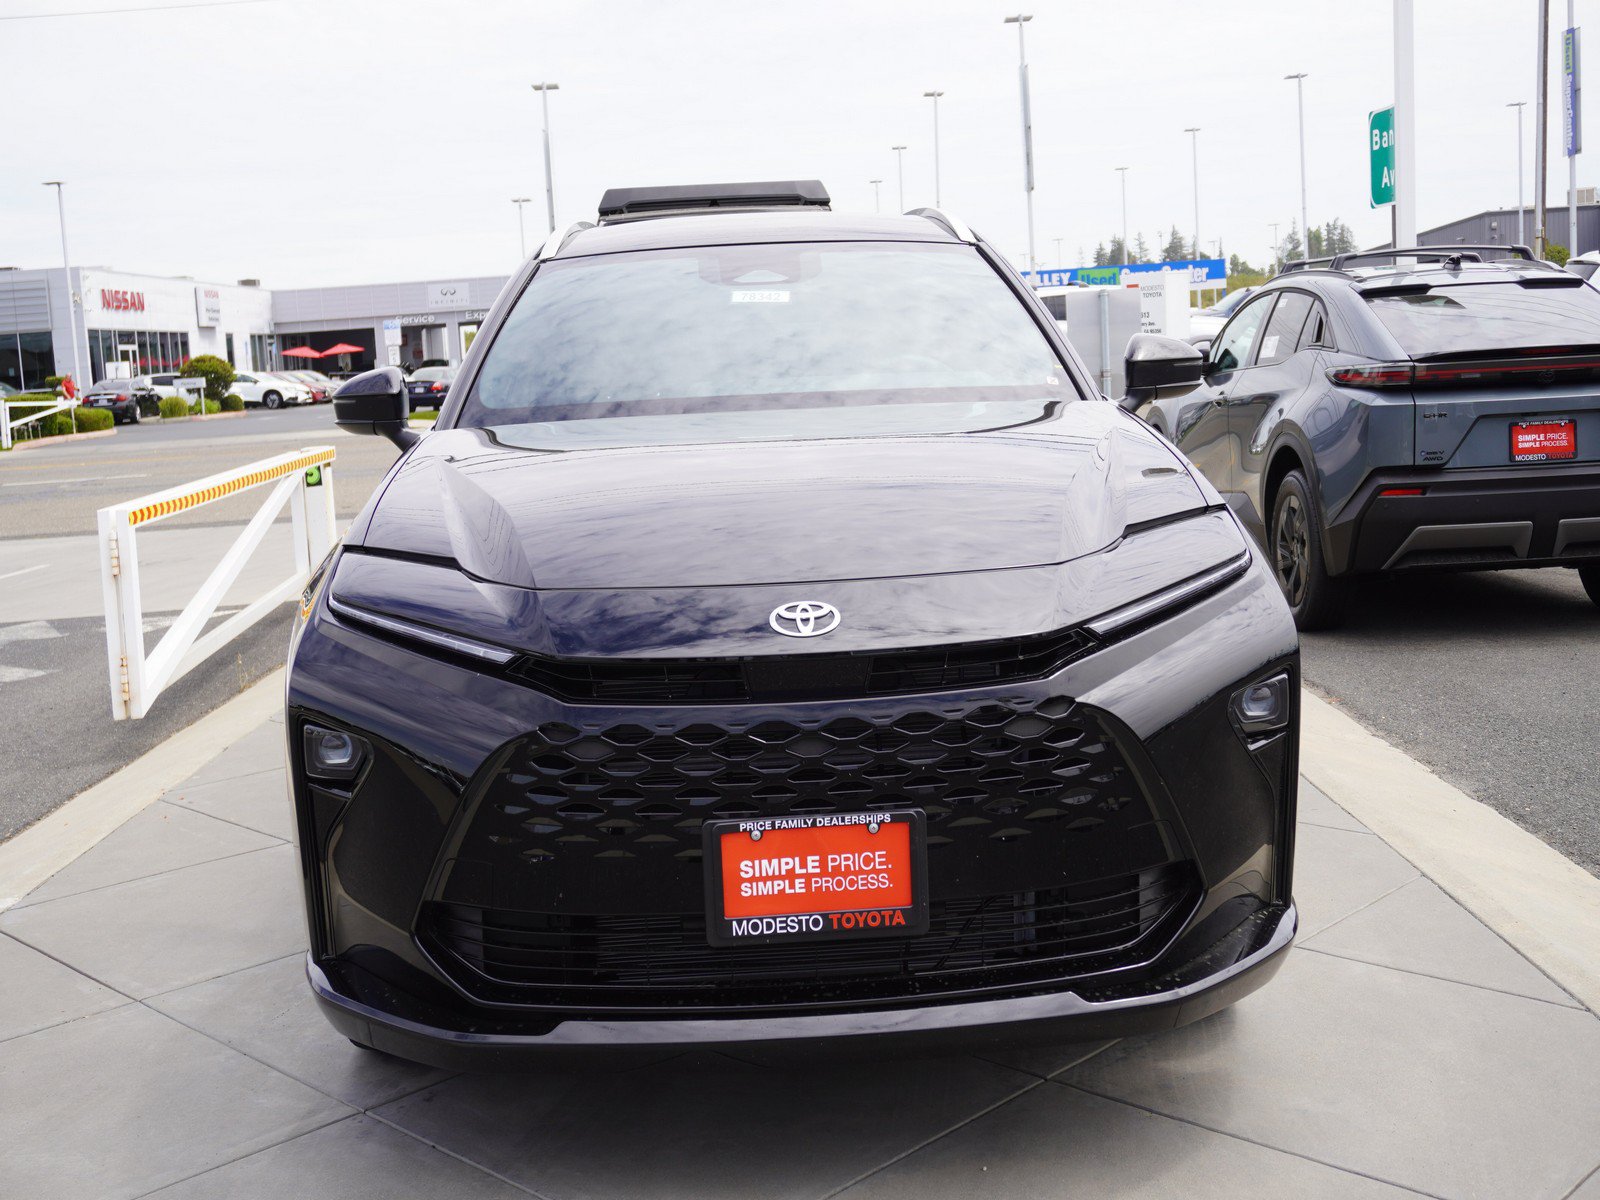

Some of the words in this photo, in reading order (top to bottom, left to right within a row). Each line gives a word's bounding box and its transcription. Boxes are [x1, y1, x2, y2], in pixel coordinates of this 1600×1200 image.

[1372, 129, 1394, 151] Ban
[1381, 166, 1395, 188] Av
[1025, 272, 1071, 287] LLEY
[1081, 273, 1117, 285] Used
[101, 289, 145, 312] NISSAN
[741, 292, 781, 301] 78342
[395, 315, 435, 324] Service
[465, 311, 488, 321] Exp
[1518, 433, 1545, 442] SIMPLE
[1546, 432, 1568, 440] PRICE.
[1515, 453, 1546, 461] MODESTO
[1547, 452, 1574, 460] TOYOTA
[739, 820, 772, 832] PRICE
[775, 818, 814, 830] FAMILY
[816, 813, 891, 827] DEALERSHIPS
[739, 855, 820, 878] SIMPLE
[827, 851, 892, 872] PRICE.
[740, 878, 806, 897] SIMPLE
[811, 873, 893, 892] PROCESS.
[732, 914, 823, 936] MODESTO
[829, 910, 905, 930] TOYOTA
